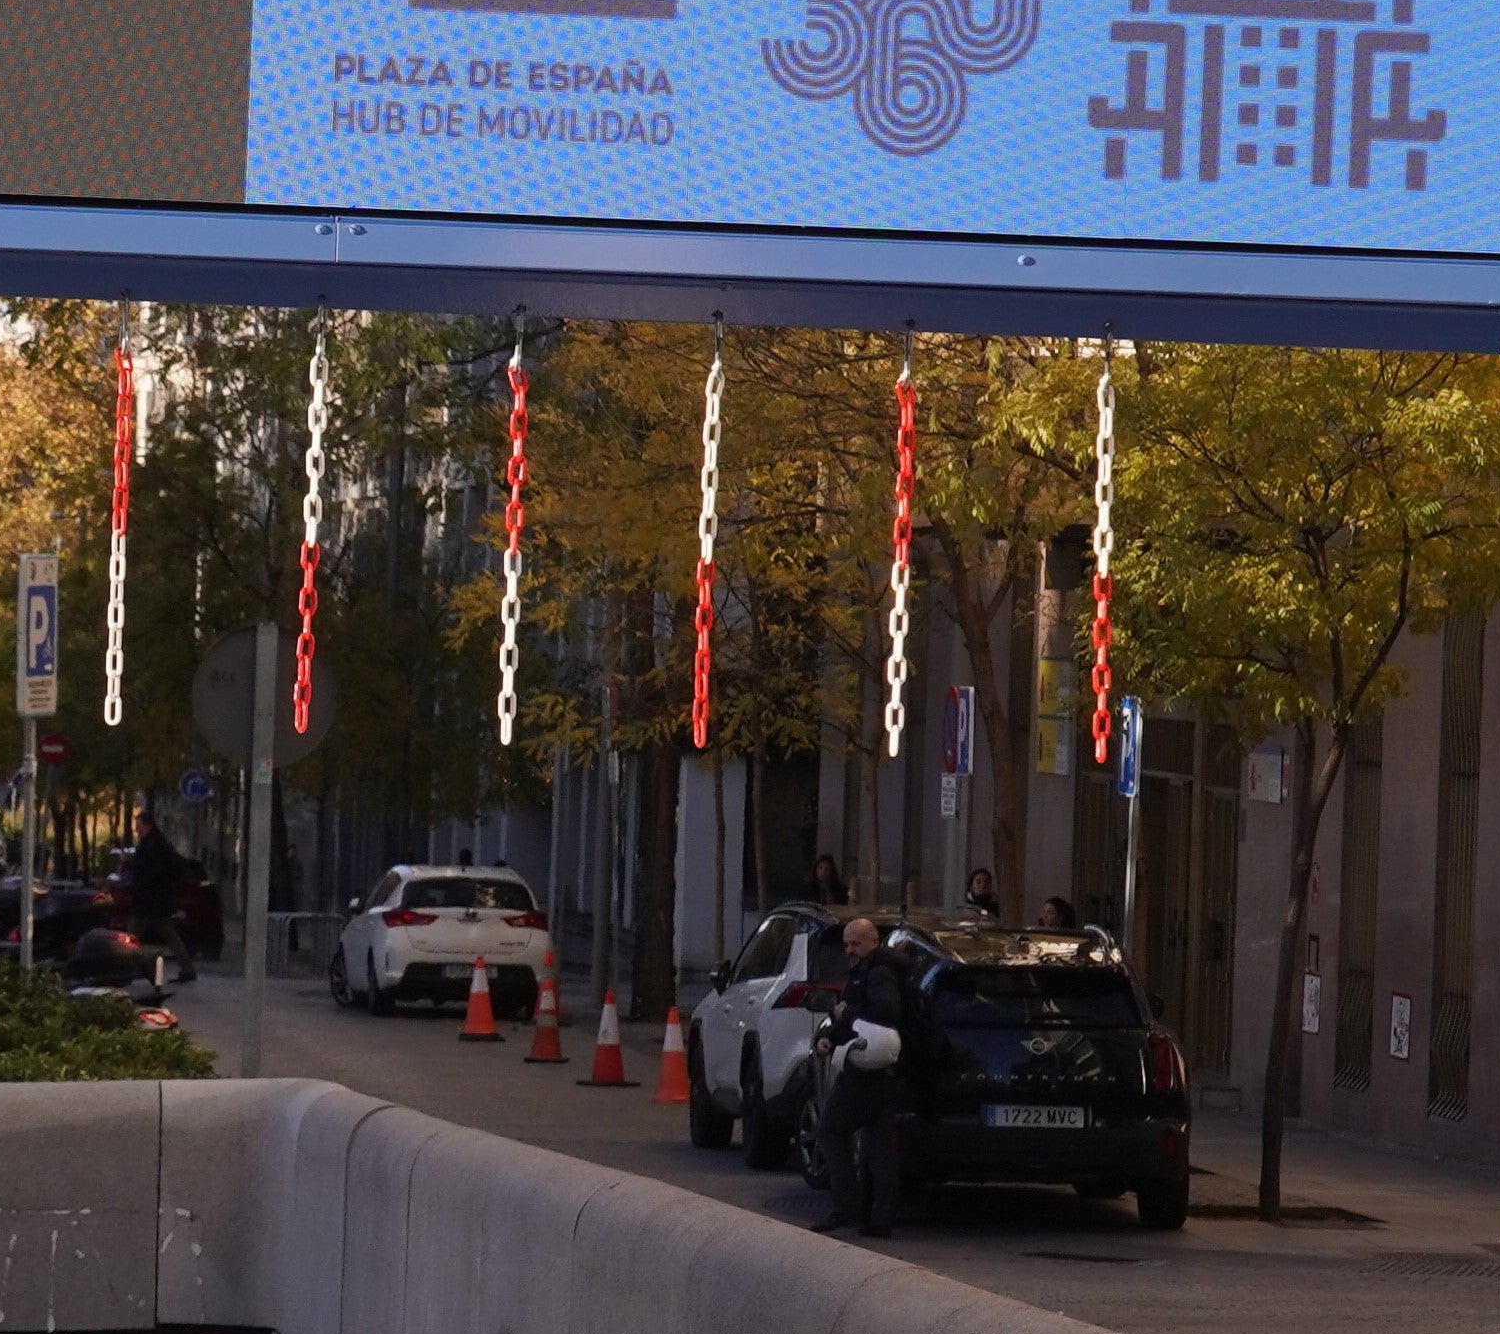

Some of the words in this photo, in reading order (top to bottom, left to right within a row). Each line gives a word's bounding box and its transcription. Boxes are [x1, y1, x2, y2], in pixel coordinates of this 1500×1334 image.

[334, 53, 453, 89] PLAZA
[469, 59, 512, 90] DE
[528, 58, 672, 96] ESPAÑA
[331, 99, 405, 135] HUB
[419, 103, 464, 138] DE
[477, 104, 674, 146] MOVILIDAD
[29, 595, 49, 668] P
[1003, 1109, 1042, 1124] 1722
[1047, 1110, 1079, 1125] MVC
